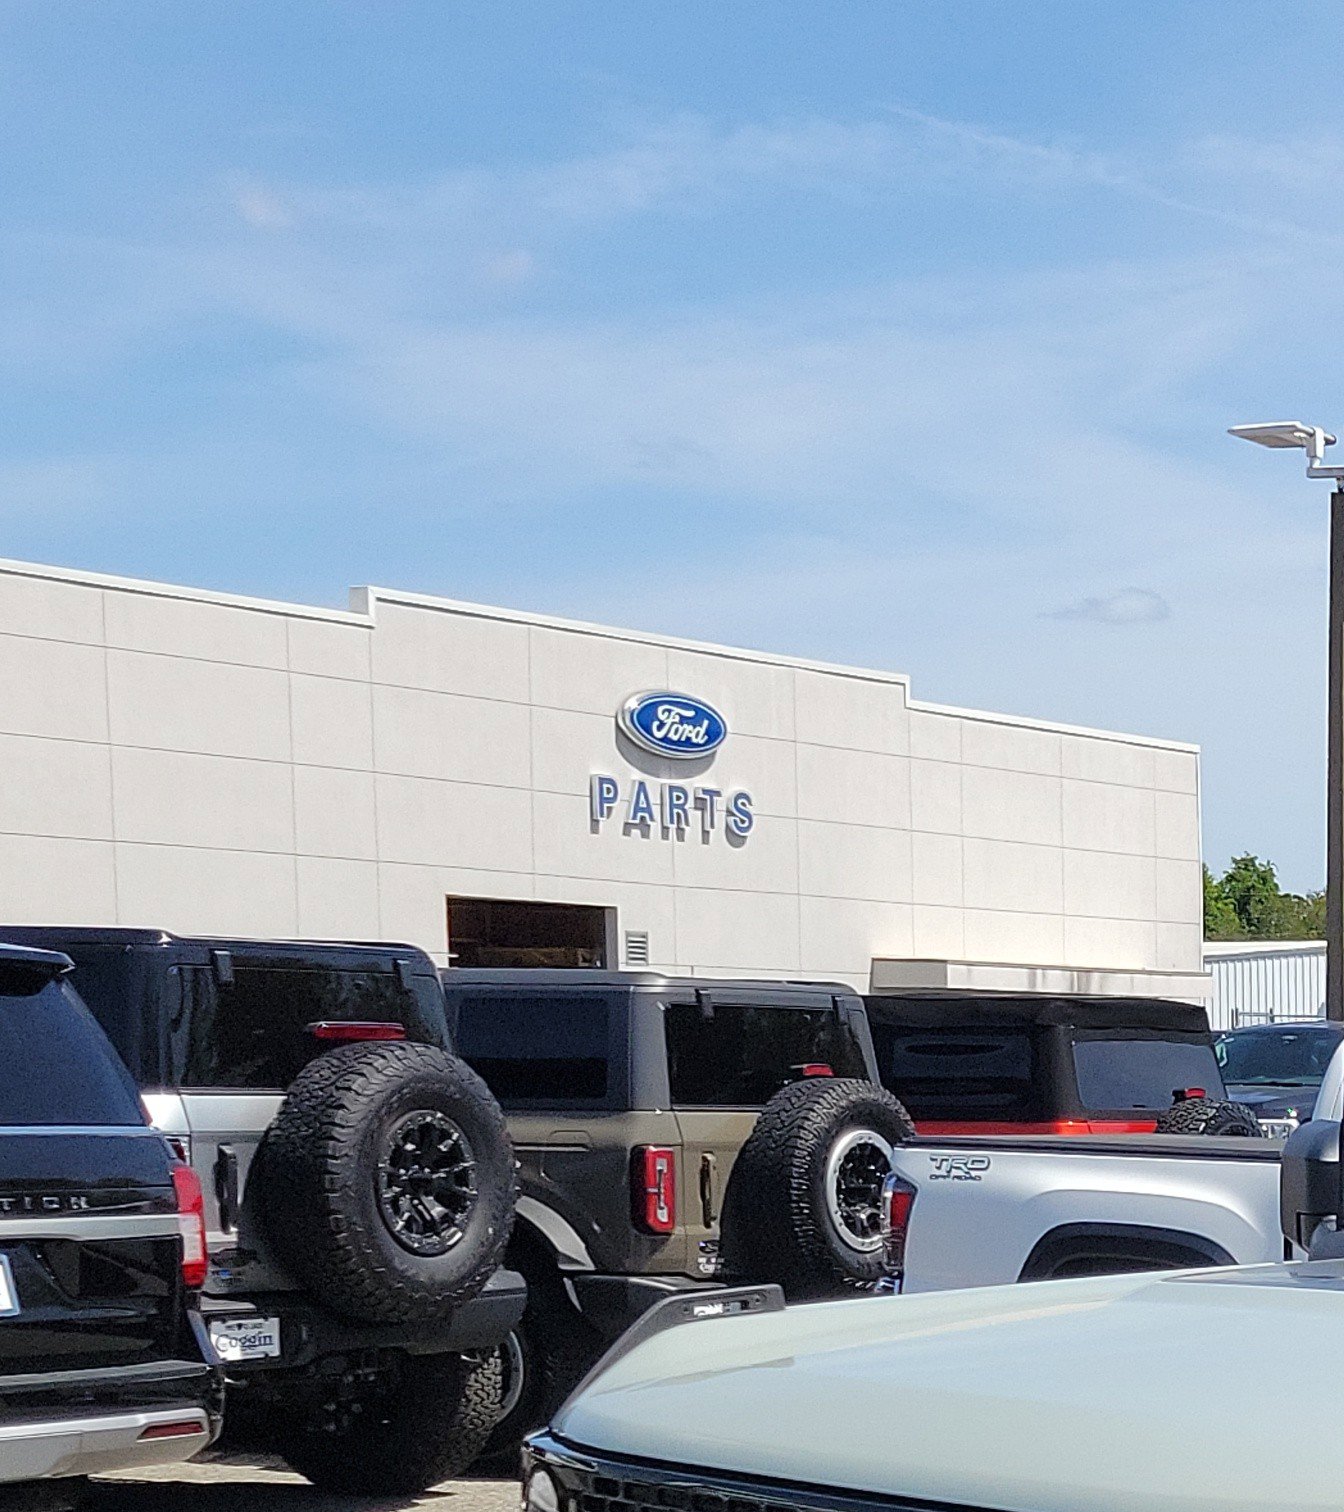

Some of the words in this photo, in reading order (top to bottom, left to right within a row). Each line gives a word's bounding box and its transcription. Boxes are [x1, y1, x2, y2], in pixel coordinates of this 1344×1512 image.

[652, 704, 709, 744] Ford
[590, 775, 754, 836] PARTS
[929, 1155, 991, 1174] TRD
